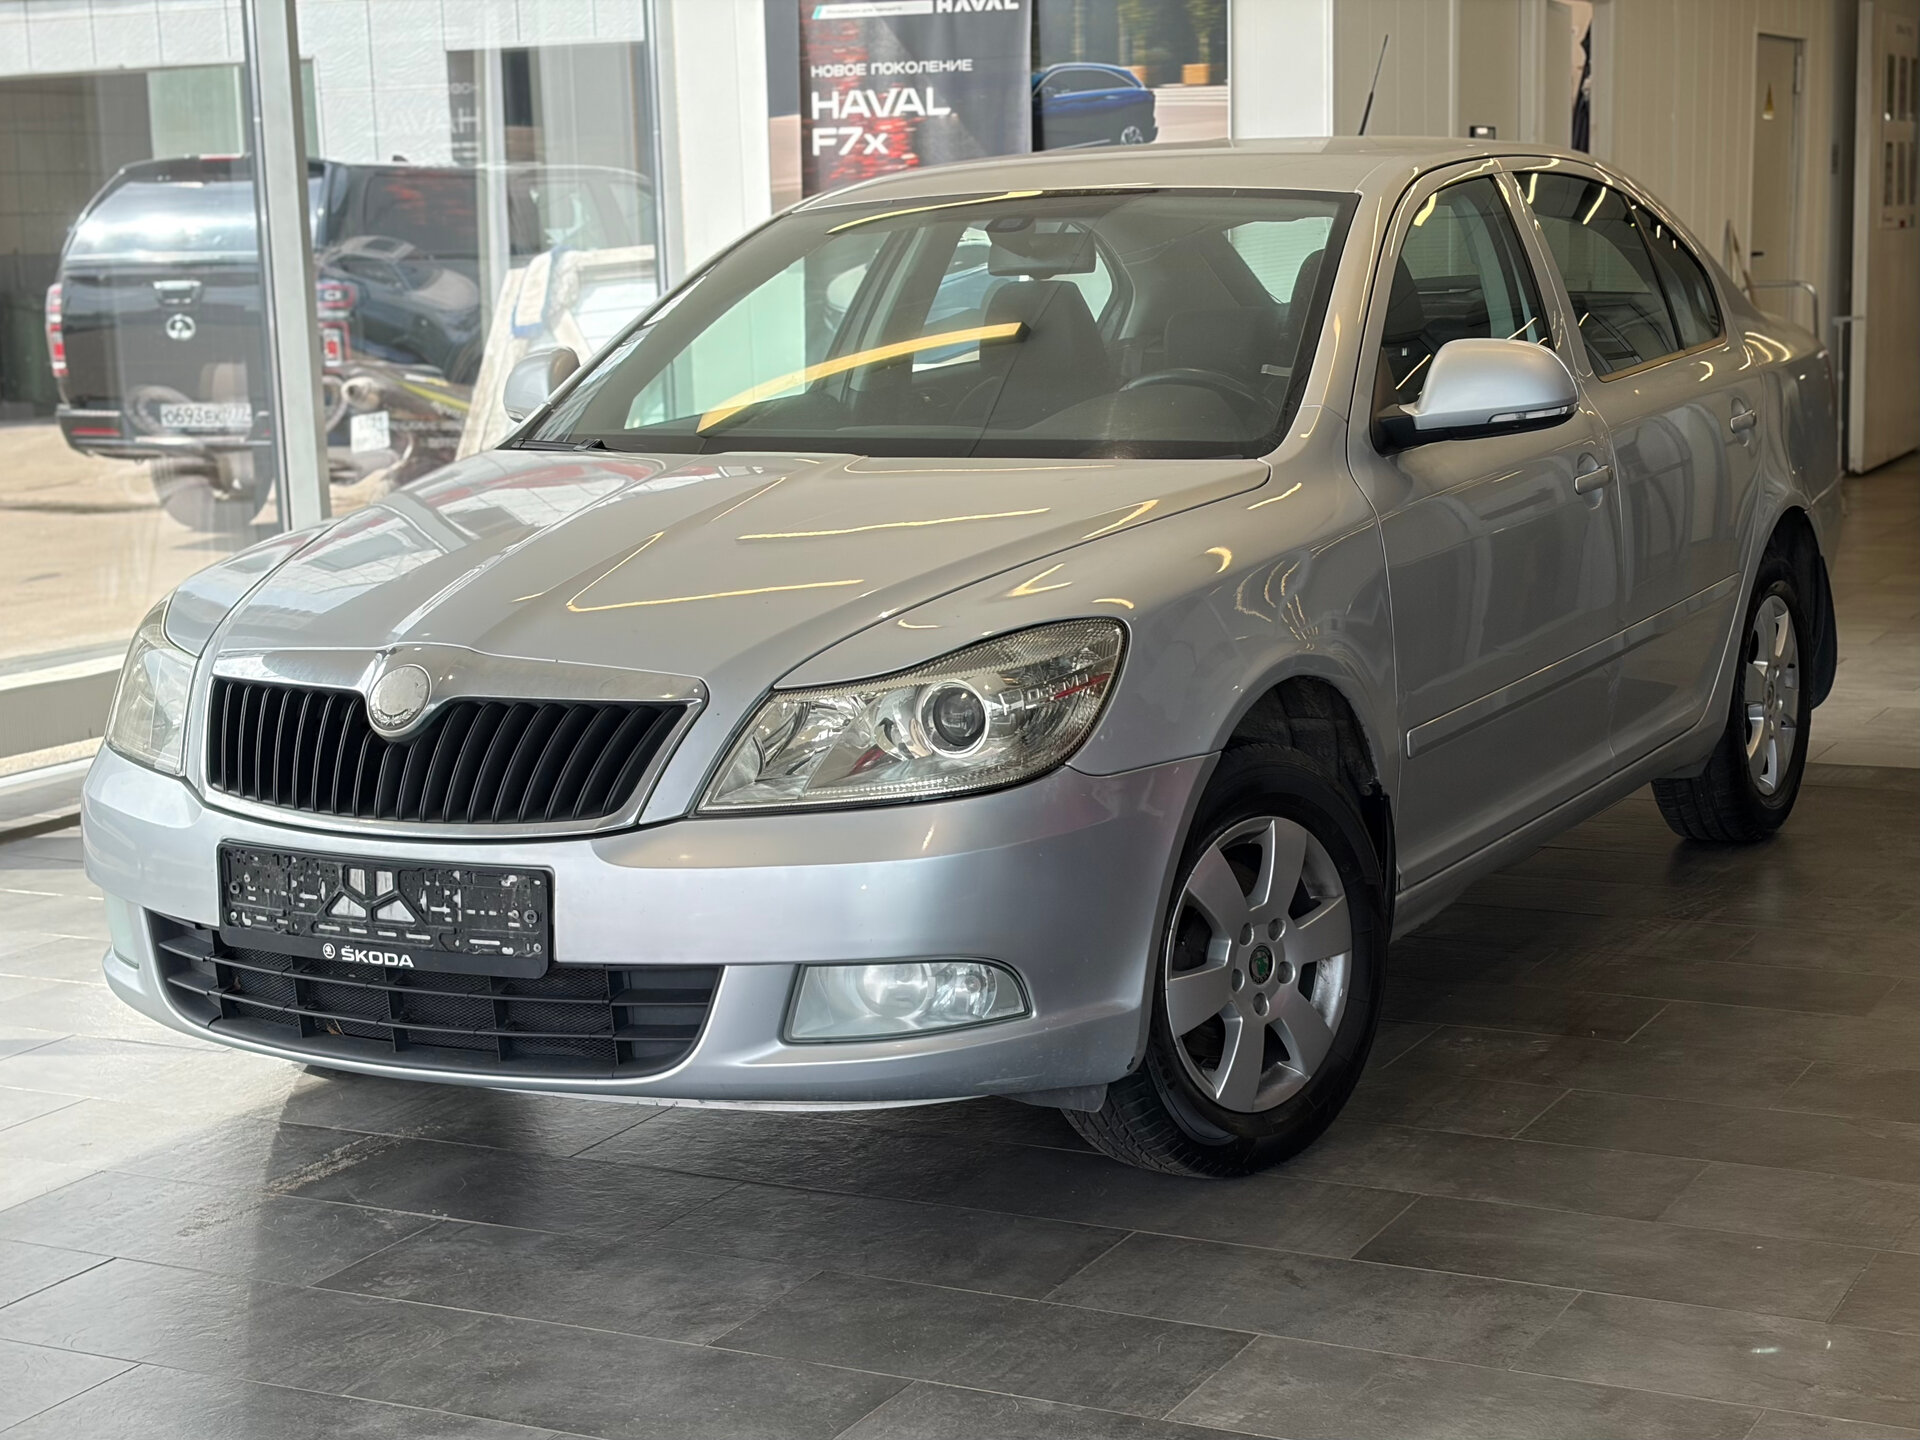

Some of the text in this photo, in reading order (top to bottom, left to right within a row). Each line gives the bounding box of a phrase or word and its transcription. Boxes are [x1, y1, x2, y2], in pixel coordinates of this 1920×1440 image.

[936, 0, 1020, 14] HAVAL
[811, 59, 974, 78] НОВОЕ ПОКОЛЕНИЕ
[811, 86, 951, 120] HAVAL
[341, 945, 414, 968] ŠKODA
